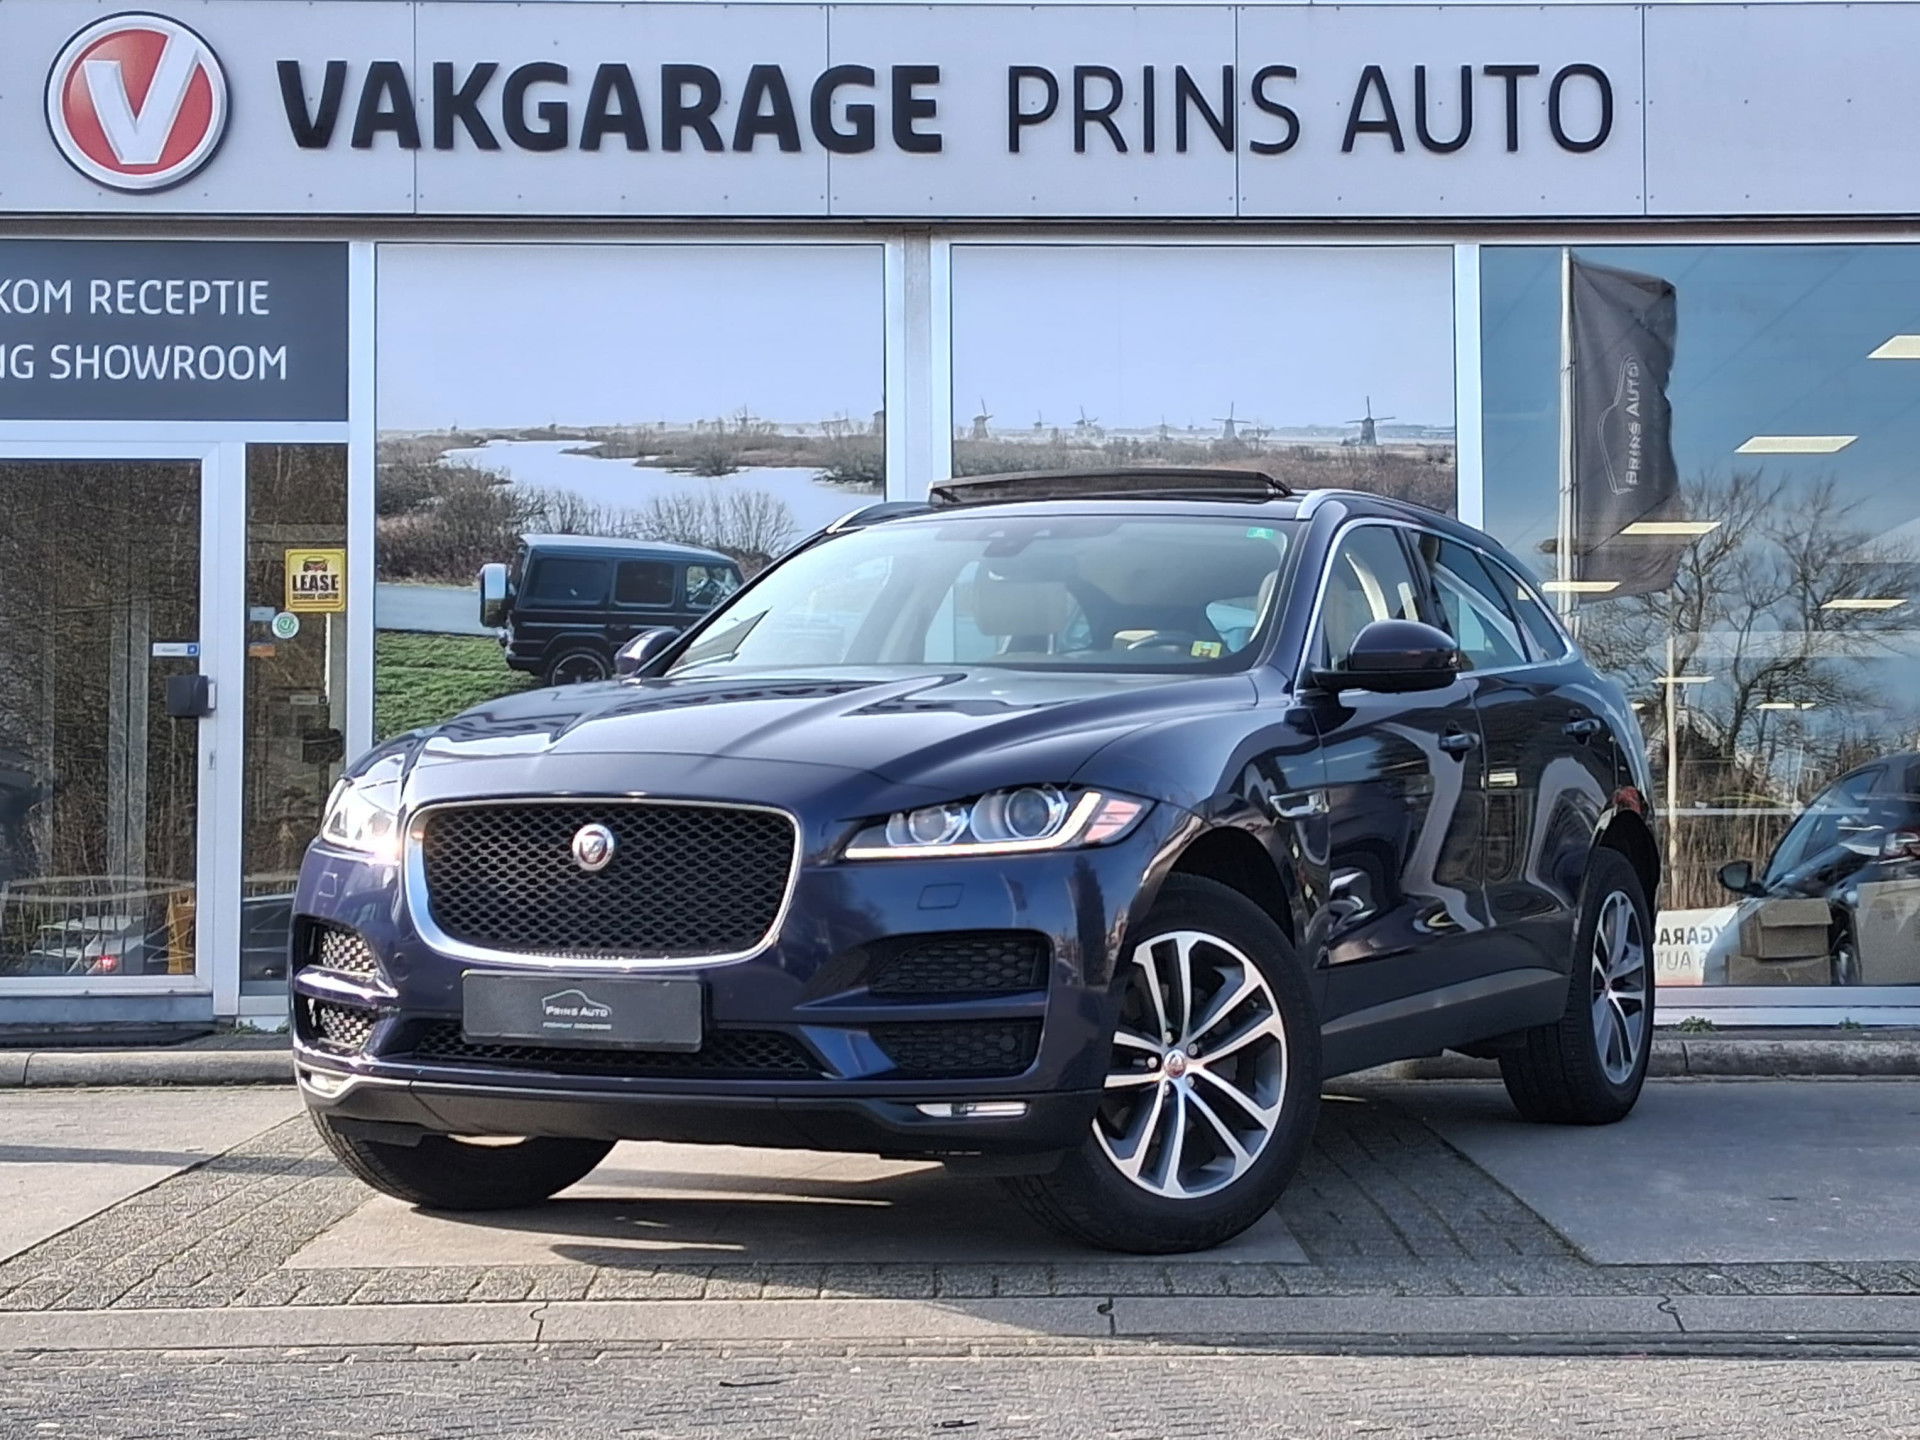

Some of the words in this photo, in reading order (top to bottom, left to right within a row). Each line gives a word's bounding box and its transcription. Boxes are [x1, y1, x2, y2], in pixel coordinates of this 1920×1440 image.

[276, 60, 943, 154] VAKGARAGE
[1008, 65, 1300, 155] PRINS
[1341, 63, 1613, 154] AUTO
[90, 279, 270, 315] RECEPTIE
[50, 344, 287, 380] SHOWROOM
[291, 574, 340, 592] LEASE
